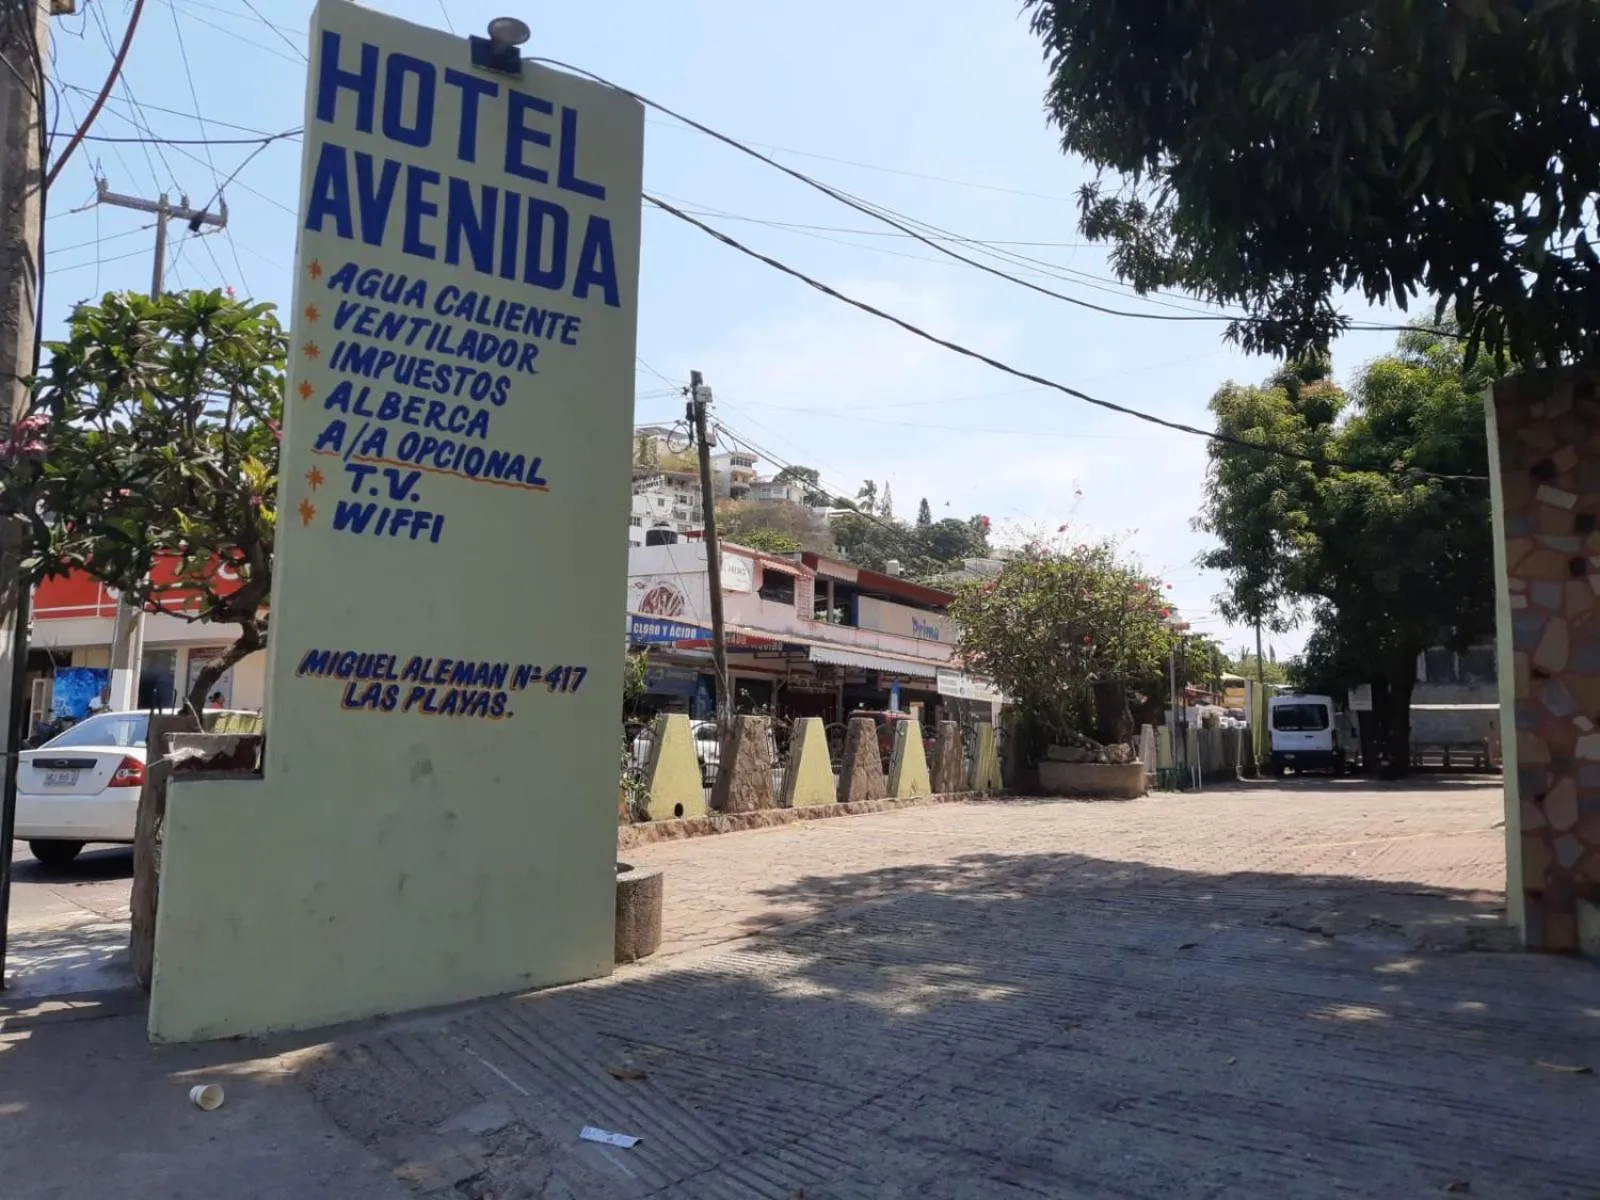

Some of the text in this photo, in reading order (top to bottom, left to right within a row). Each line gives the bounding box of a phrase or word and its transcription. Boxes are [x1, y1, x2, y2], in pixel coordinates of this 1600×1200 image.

[316, 29, 606, 201] HOTEL
[305, 141, 621, 308] AVENIDA
[327, 262, 582, 346] AGUA CALIENTE
[333, 300, 540, 375] VENTILADOR
[329, 340, 512, 407] IMPUESTOS
[324, 380, 490, 439] ALBERCA
[313, 419, 547, 486] A/A OPCIONAL
[345, 463, 421, 502] T.V.
[332, 500, 445, 543] WIFFI
[633, 622, 660, 636] CLORO
[662, 625, 668, 636] Y
[297, 648, 399, 681] MIGUEL
[402, 655, 509, 689] ALEMAN
[341, 681, 514, 720] LAS PLAYAS.
